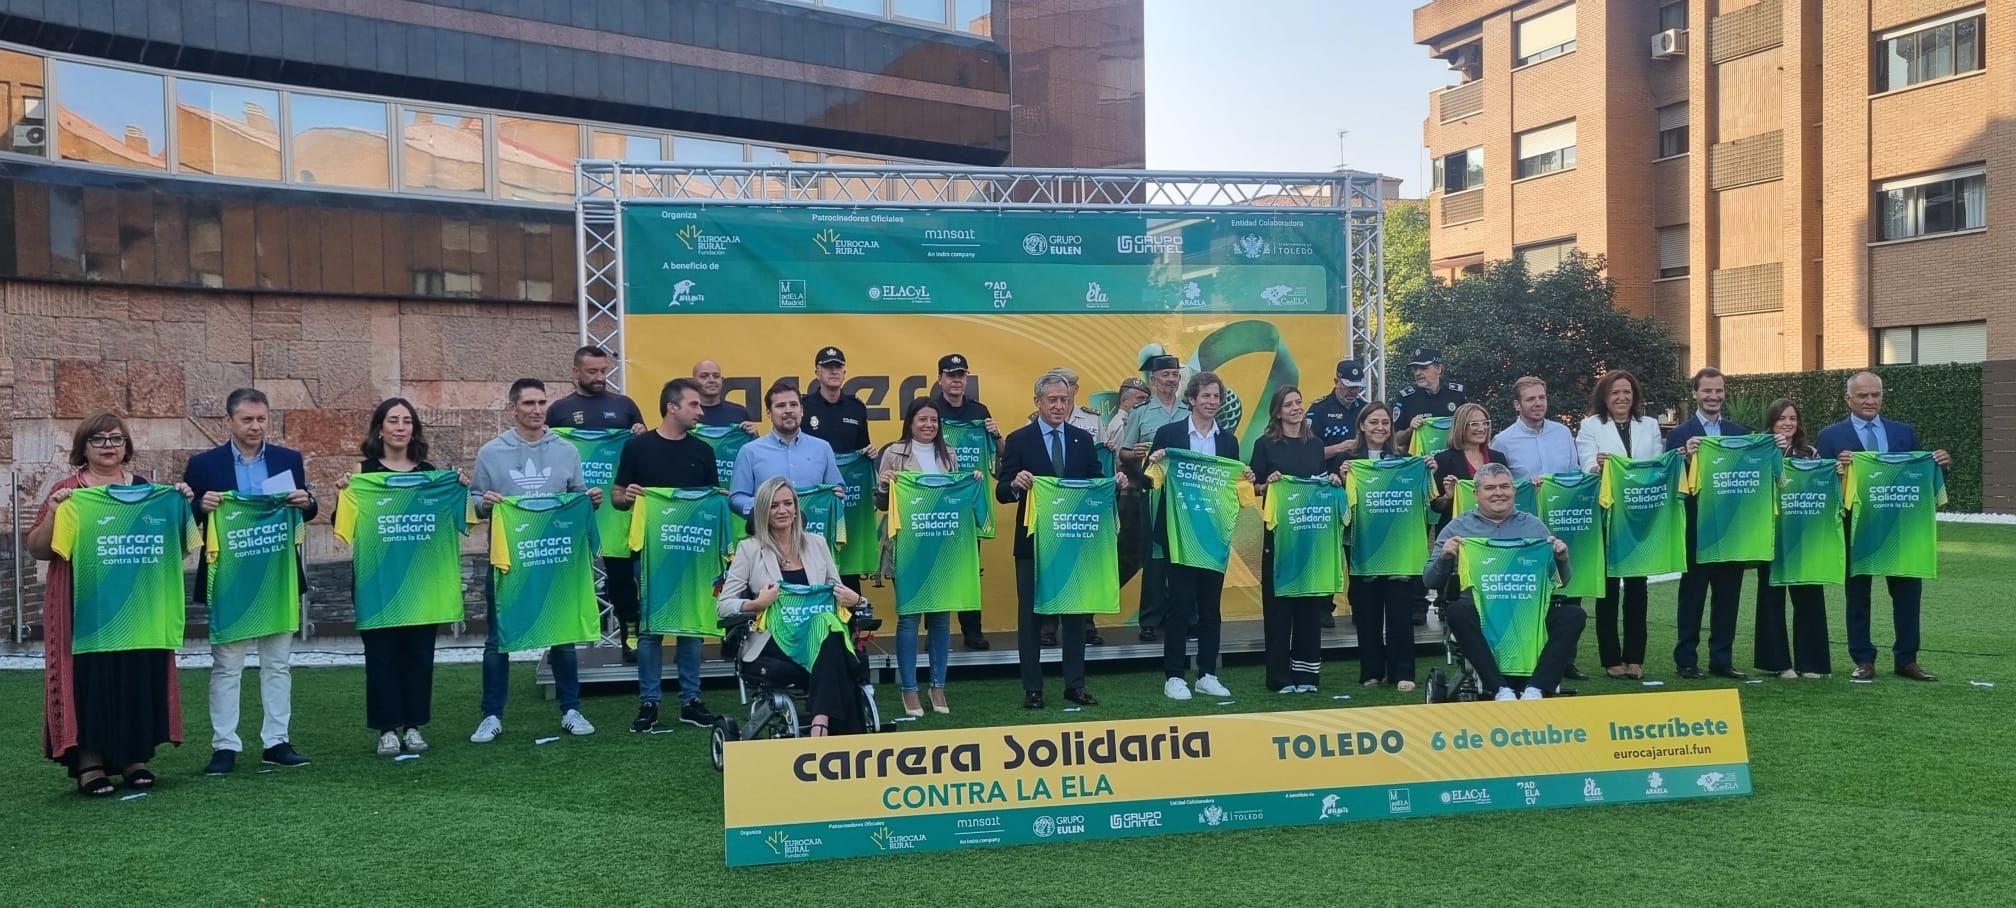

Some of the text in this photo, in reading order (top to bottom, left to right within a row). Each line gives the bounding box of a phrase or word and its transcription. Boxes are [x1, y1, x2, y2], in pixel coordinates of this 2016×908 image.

[661, 210, 697, 220] Organiza
[812, 214, 904, 223] Patrocinadores Oficiales
[698, 235, 741, 243] EUROCAJA
[835, 240, 880, 248] EUROCAJA
[1049, 235, 1082, 245] GRUPO
[1134, 236, 1183, 245] GRUPO
[1050, 246, 1082, 255] EULEN
[1134, 245, 1184, 254] UNITEL
[671, 262, 708, 270] beneficio
[709, 262, 720, 270] de
[882, 286, 930, 299] ELACyL
[994, 290, 1012, 299] ELA
[994, 300, 1006, 308] CV
[580, 462, 612, 470] rrera
[1178, 462, 1231, 478] carrera
[1177, 469, 1227, 486] Solidaria
[1712, 470, 1760, 479] carrera
[1712, 478, 1760, 488] Solidaria
[1623, 485, 1667, 495] carrera
[1869, 484, 1920, 493] carrera
[1365, 490, 1413, 498] carrera
[1623, 492, 1668, 503] Solidaria
[1781, 492, 1826, 500] carrera
[1869, 491, 1919, 501] Solidaria
[1365, 497, 1413, 507] Solidaria
[1781, 500, 1825, 509] Solidaria
[911, 512, 959, 521] carrera
[1288, 506, 1331, 517] carrera
[1548, 508, 1593, 517] carrera
[377, 513, 435, 523] carrera
[1052, 513, 1099, 521] carrera
[1288, 514, 1331, 524] Solidaria
[1549, 515, 1592, 525] Solidaria
[378, 523, 435, 534] Solidaria
[911, 520, 959, 530] Solidaria
[1053, 521, 1099, 531] Solidaria
[227, 522, 288, 540] carrera
[660, 524, 712, 537] carrera
[97, 534, 164, 545] carrera
[228, 533, 288, 550] Solidaria
[383, 534, 406, 542] contra
[517, 536, 572, 550] carrera
[660, 533, 710, 546] Solidaria
[97, 544, 164, 556] Solidaria
[234, 548, 261, 558] contra
[271, 544, 286, 552] ELA
[518, 546, 572, 559] Solidaria
[103, 557, 132, 565] contra
[142, 556, 159, 564] ELA
[523, 558, 545, 567] contra
[555, 556, 568, 564] ELA
[1481, 572, 1536, 582] carrera
[1481, 581, 1536, 592] Solidaria
[1518, 592, 1532, 600] ELA
[780, 604, 833, 616] carrera
[1609, 716, 1729, 741] Inscríbete
[1431, 724, 1587, 751] 6 de Octubre
[1272, 729, 1404, 760] TOLEDO
[793, 725, 1211, 782] carrera Solidaria
[1613, 744, 1712, 761] eurocajarural.fun
[883, 773, 1114, 810] CONTRA LA ELA
[1451, 789, 1490, 801] ELACyL
[1056, 815, 1084, 825] GRUPO
[1123, 811, 1162, 821] GRUPO
[1234, 812, 1263, 820] TOLEDO
[1124, 818, 1162, 828] UNITEL
[1057, 825, 1084, 834] EULEN
[784, 838, 823, 847] EUROCAJA
[889, 834, 927, 842] EUROCAJA
[889, 841, 914, 849] RURAL
